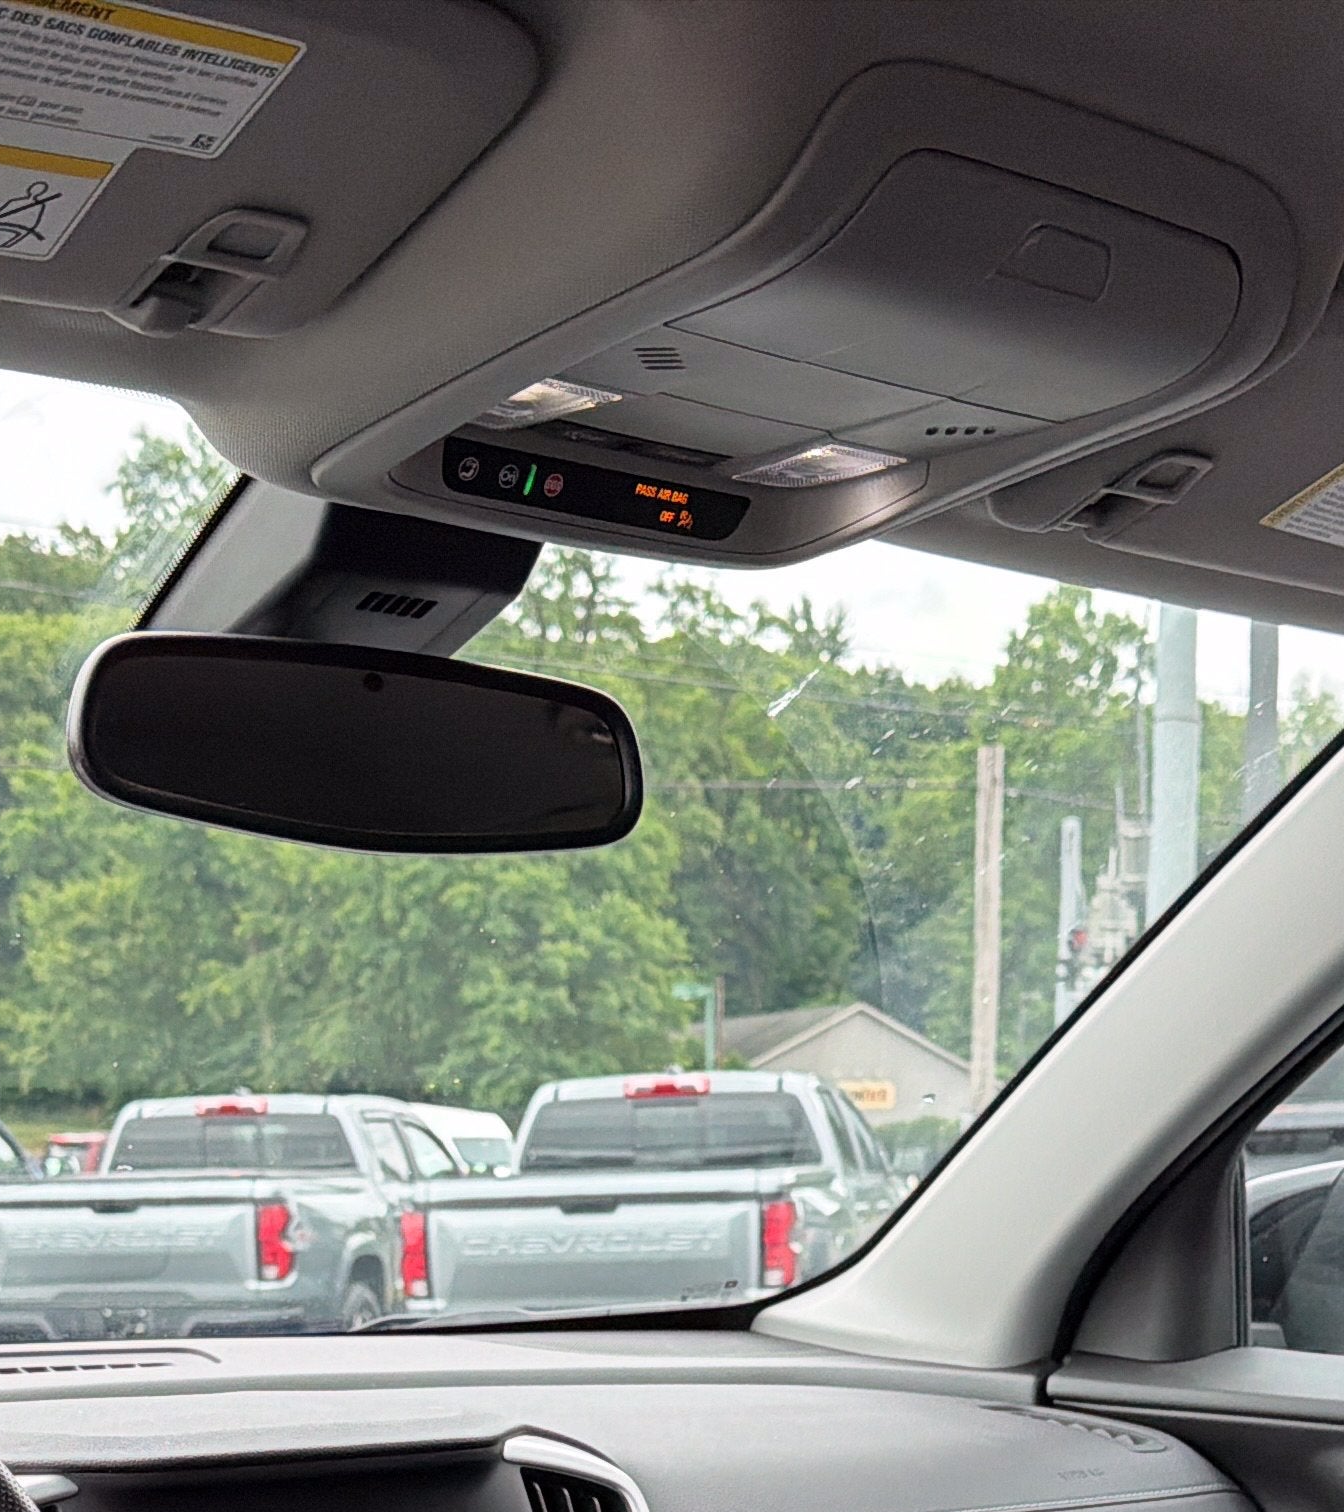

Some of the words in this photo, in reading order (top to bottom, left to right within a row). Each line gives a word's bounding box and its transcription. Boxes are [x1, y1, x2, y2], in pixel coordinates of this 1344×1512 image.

[635, 483, 656, 498] PASS
[657, 489, 672, 501] AIR
[672, 491, 689, 504] BAG
[659, 510, 676, 523] OFF
[461, 1231, 722, 1257] CHEVROLET
